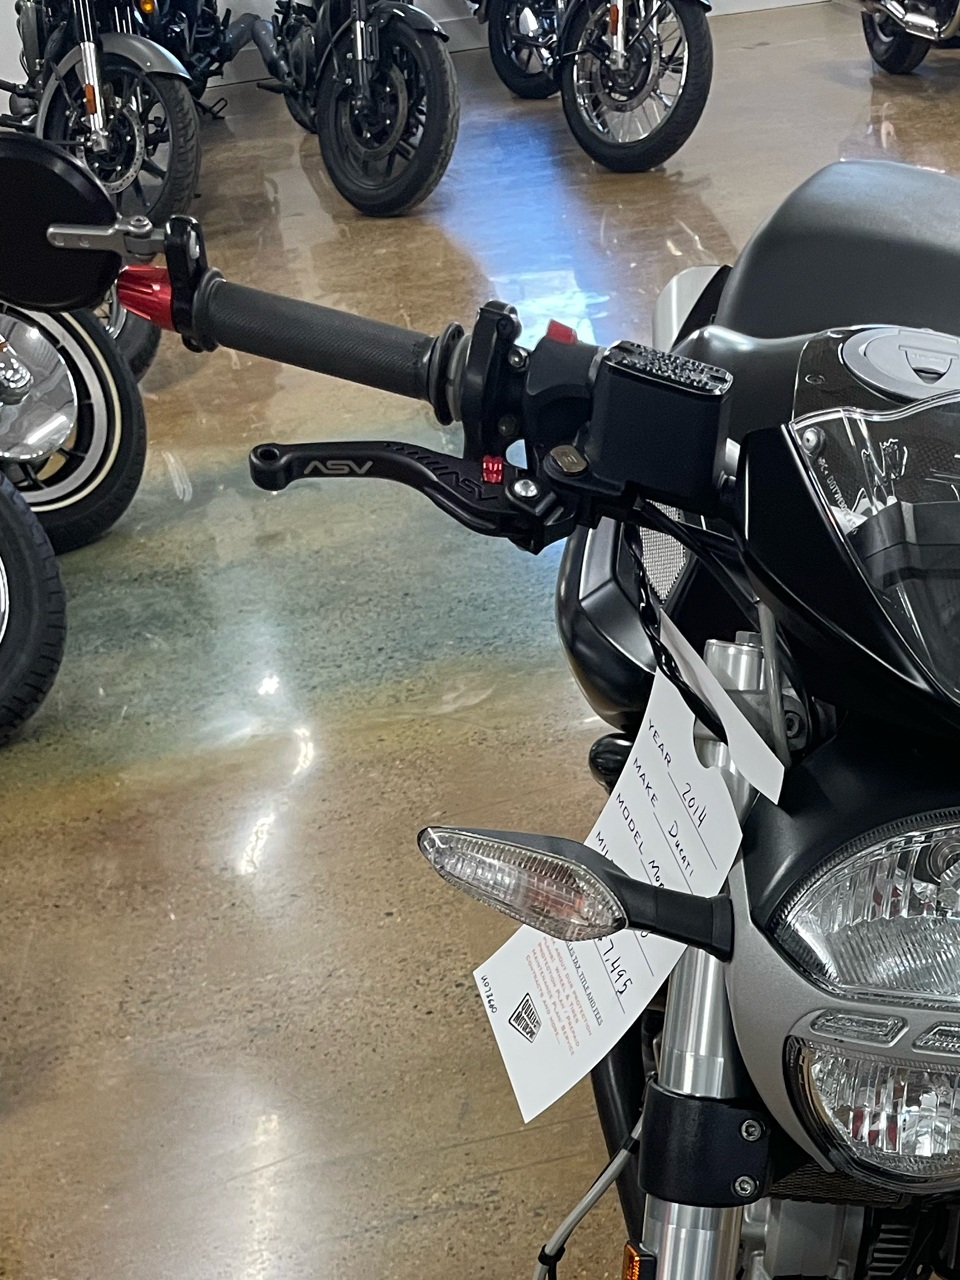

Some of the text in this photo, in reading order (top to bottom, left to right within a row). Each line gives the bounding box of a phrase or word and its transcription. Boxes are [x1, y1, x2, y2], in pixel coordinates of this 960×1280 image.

[303, 460, 373, 475] ASV
[632, 757, 659, 807] MAKE
[649, 718, 707, 828] YEAR 2014
[616, 793, 647, 855] MODEL
[598, 936, 633, 995] 7,495
